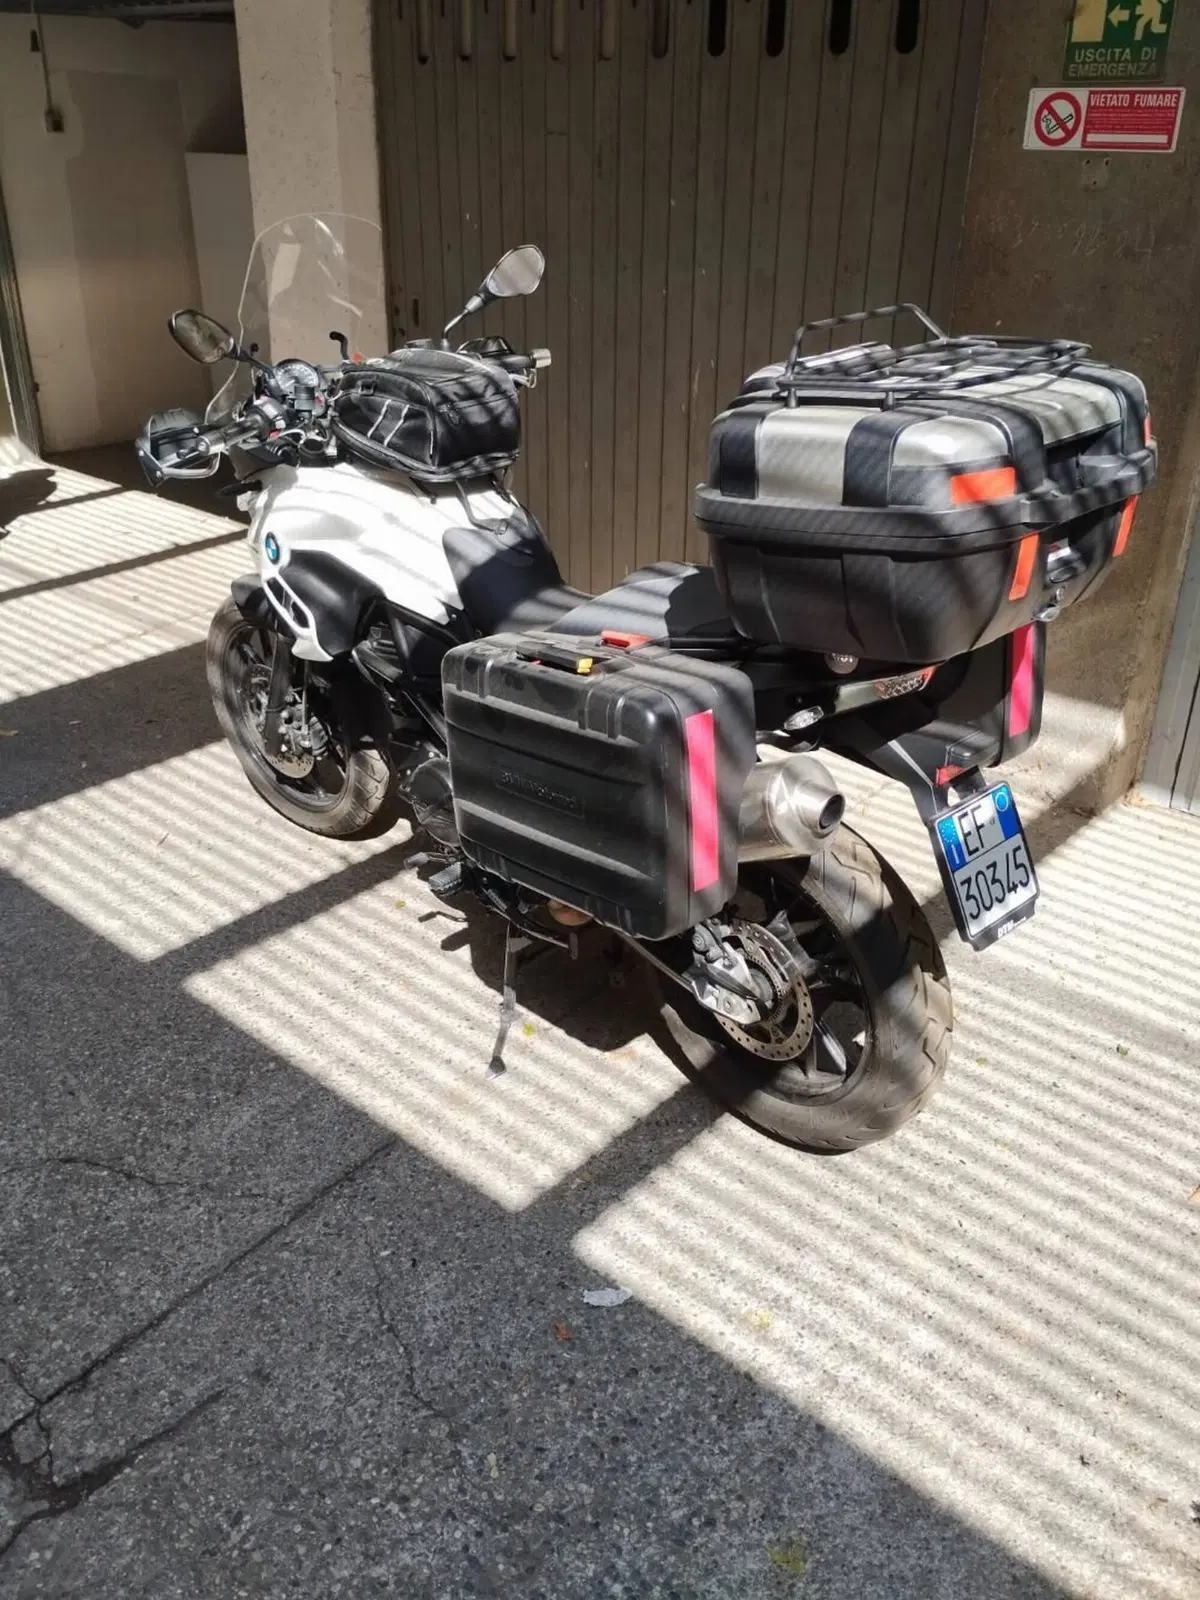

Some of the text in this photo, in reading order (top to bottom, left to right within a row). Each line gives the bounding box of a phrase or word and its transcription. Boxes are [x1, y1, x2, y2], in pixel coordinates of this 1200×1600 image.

[1075, 47, 1156, 62] USCITA DI
[1068, 62, 1157, 77] EMERGENZA
[1090, 94, 1179, 107] VIETATO FUMARE
[957, 805, 985, 857] EF
[960, 845, 1030, 920] 30345
